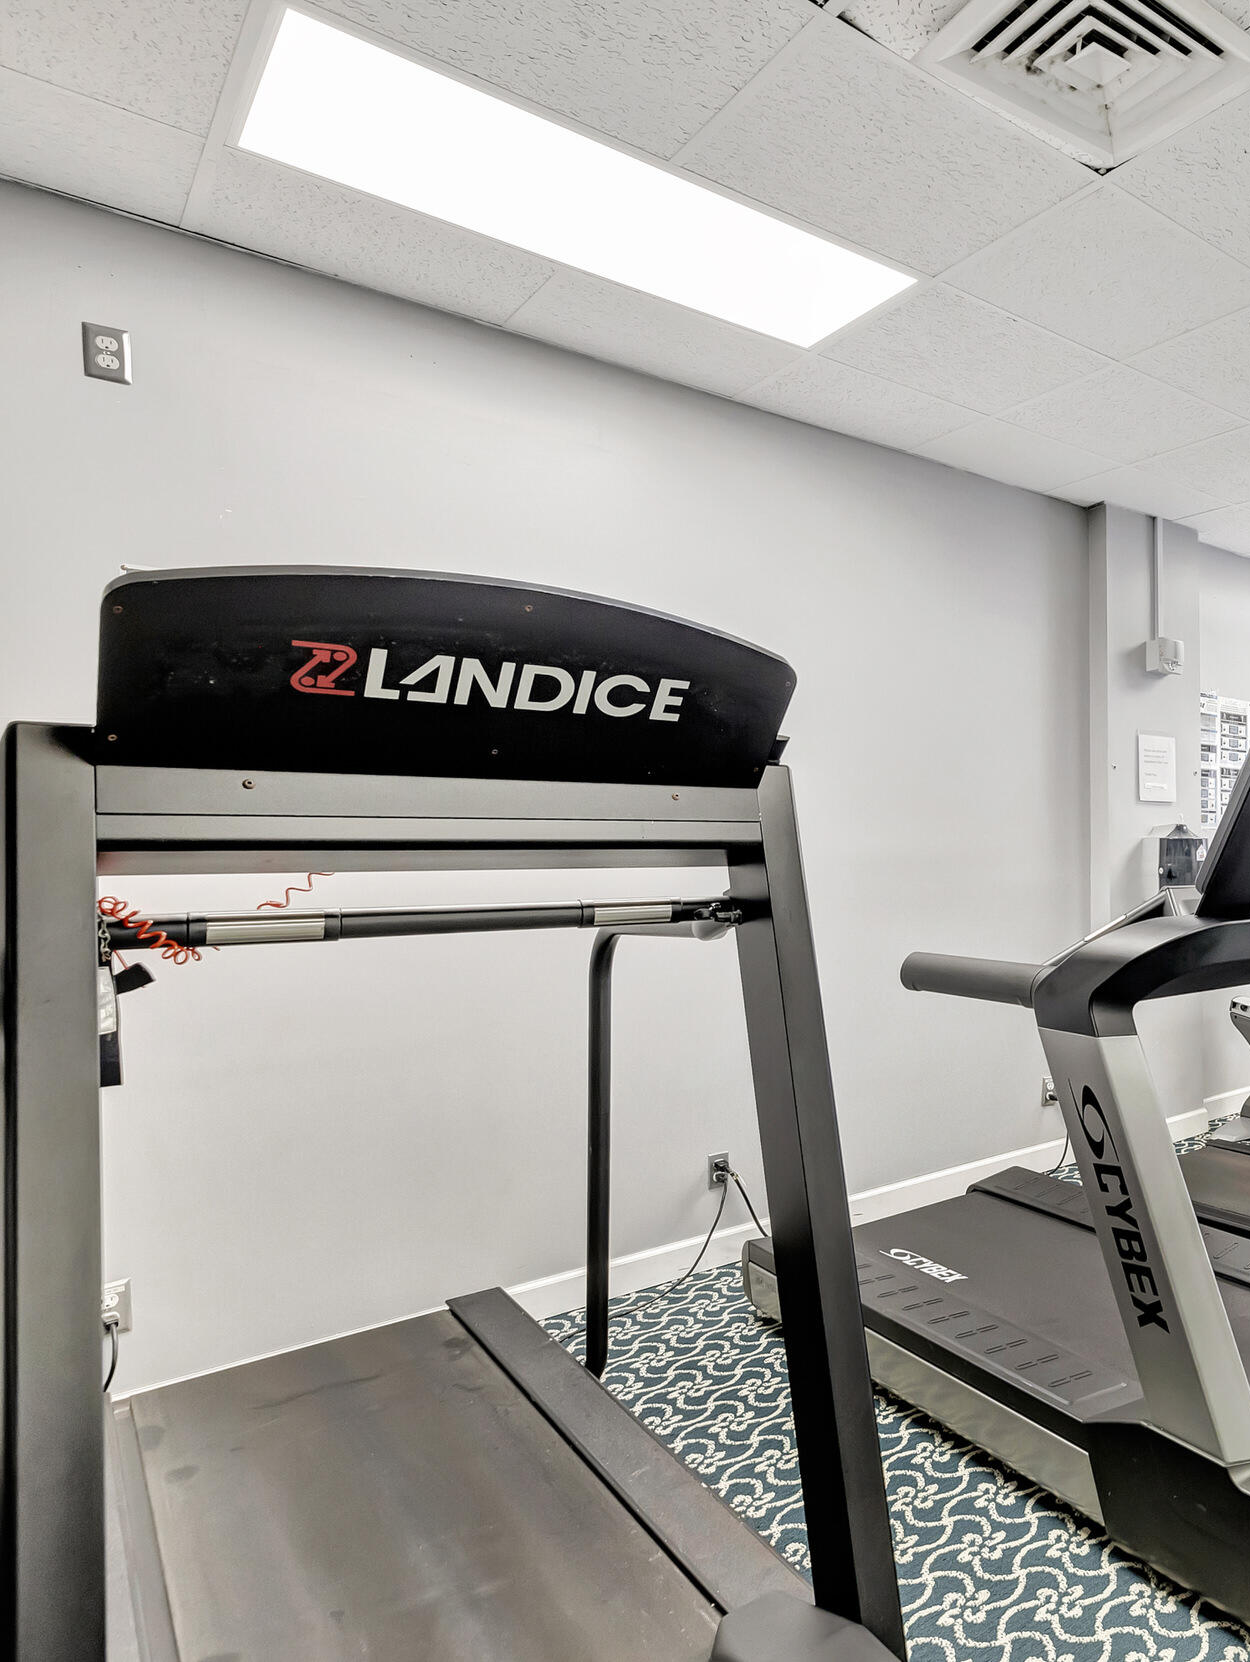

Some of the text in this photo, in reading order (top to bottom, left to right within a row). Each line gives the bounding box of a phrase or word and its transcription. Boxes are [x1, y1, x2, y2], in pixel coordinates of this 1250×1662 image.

[364, 648, 691, 722] LANDICE
[901, 1256, 969, 1284] CYBEX
[1092, 1162, 1171, 1335] CYBEX
